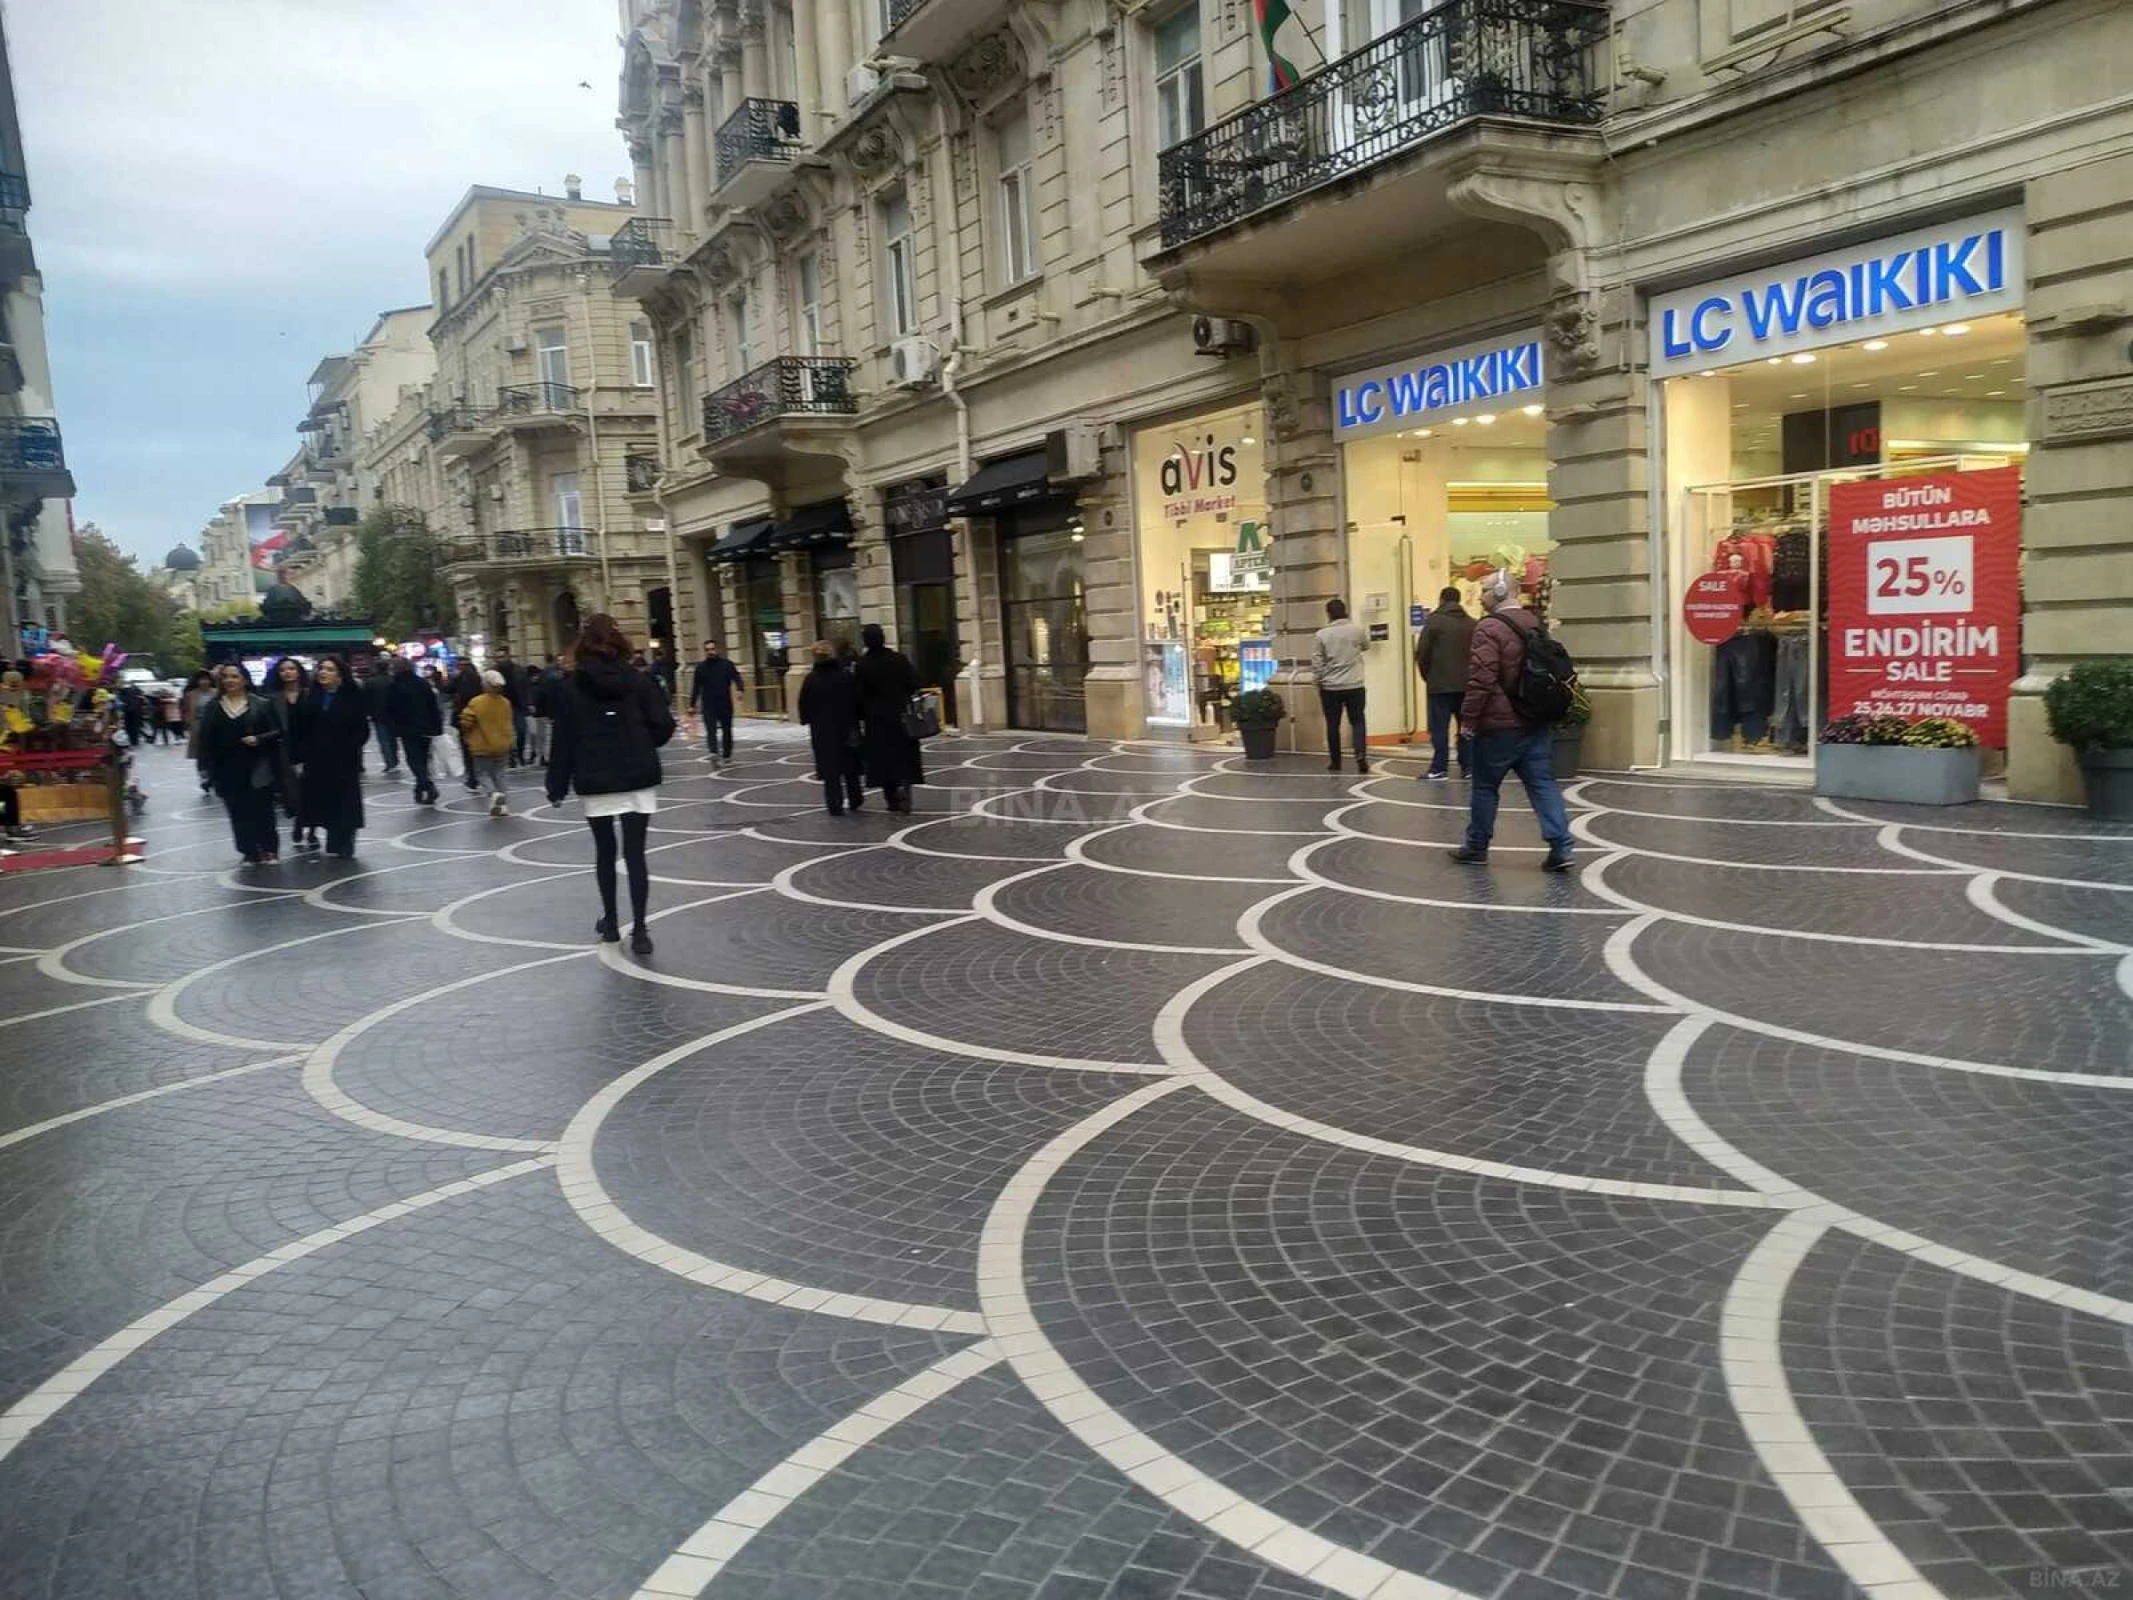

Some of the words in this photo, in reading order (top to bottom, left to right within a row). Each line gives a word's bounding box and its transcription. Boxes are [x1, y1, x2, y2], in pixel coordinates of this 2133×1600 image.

[1663, 297, 1735, 359] LC
[1339, 382, 1384, 428] LC
[1194, 495, 1236, 513] Market
[1882, 485, 1952, 509] BÜTÜN
[1852, 508, 1991, 534] MƏHSULLARA
[1697, 580, 1729, 592] SALE
[1876, 556, 1966, 598] 25%
[1845, 618, 2000, 657] ENDİRİM
[1886, 661, 1952, 682] SALE
[1918, 703, 1989, 718] NOYABR
